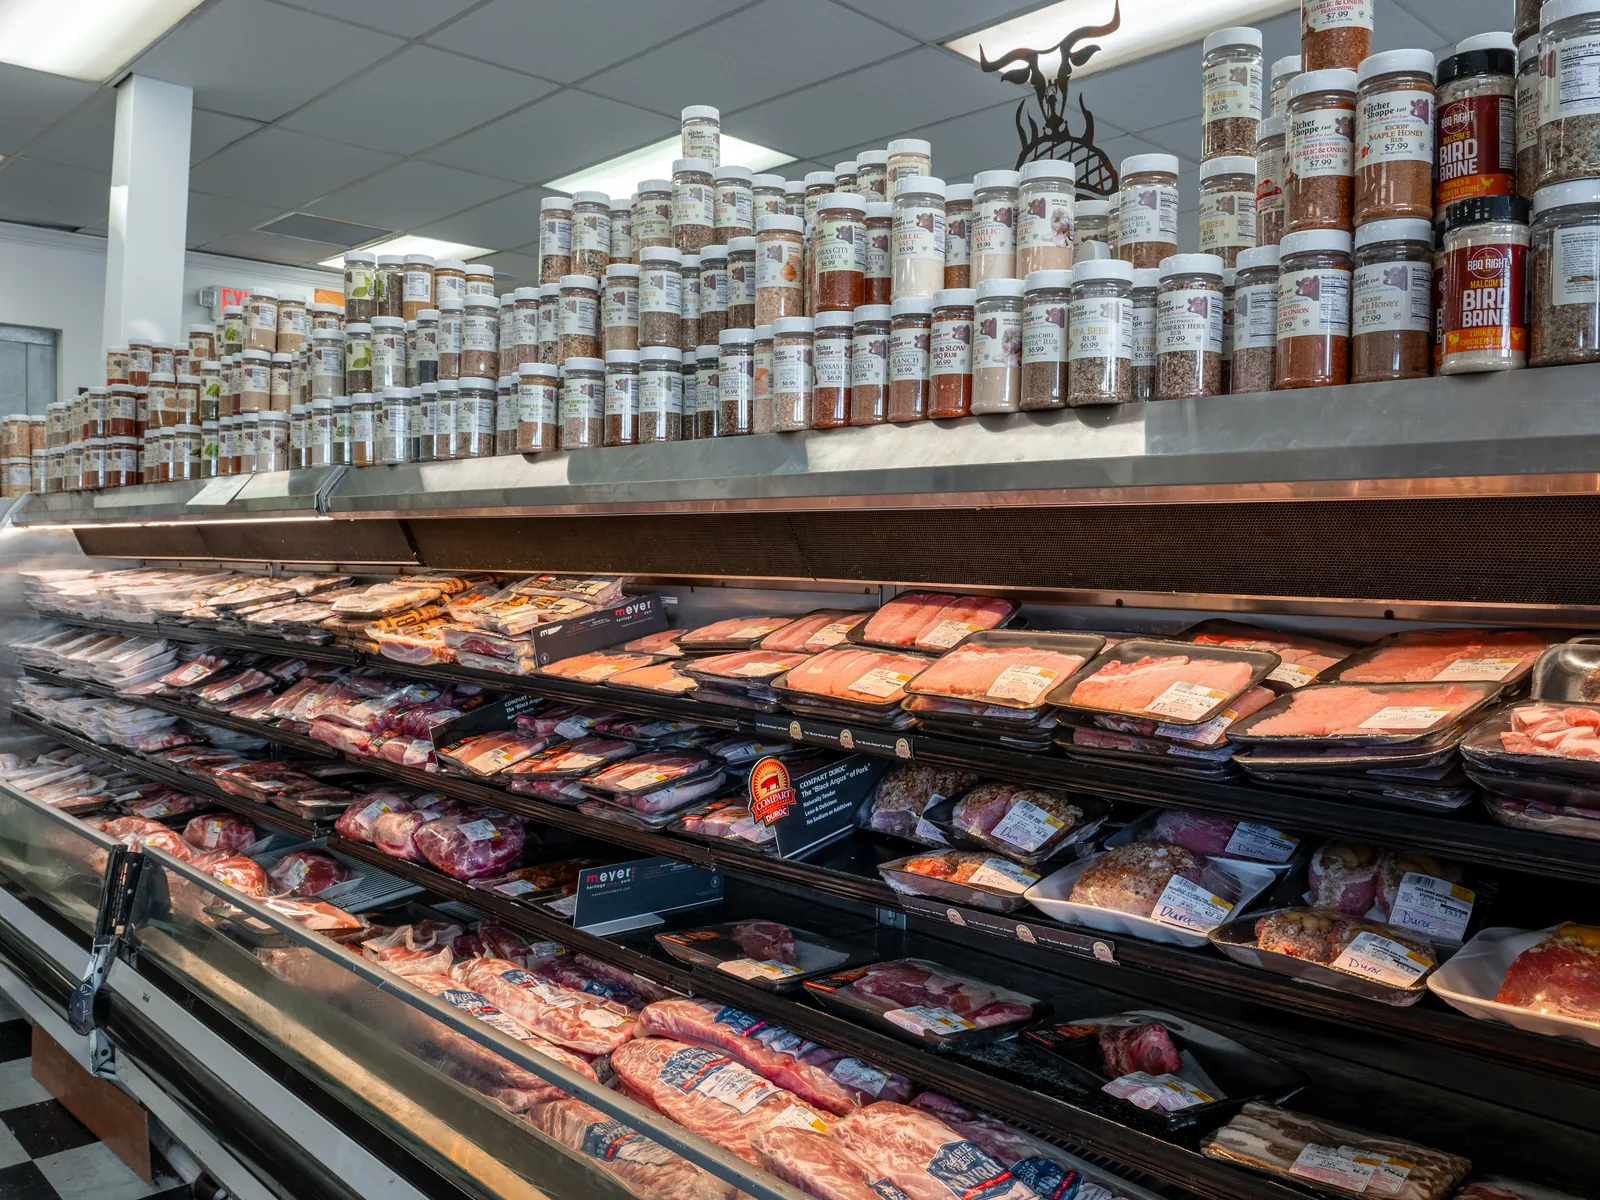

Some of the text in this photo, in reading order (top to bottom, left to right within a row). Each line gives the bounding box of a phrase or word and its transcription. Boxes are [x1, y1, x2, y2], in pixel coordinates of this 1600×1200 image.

[1311, 2, 1333, 12] GARLIC
[1320, 5, 1354, 14] SEASONING
[1326, 11, 1348, 20] $7.99
[1217, 90, 1239, 99] BEER
[1212, 98, 1227, 106] RUB
[1211, 104, 1228, 113] $6.99
[1363, 101, 1391, 115] Butcher
[1367, 108, 1394, 120] Shoppe
[1441, 110, 1474, 129] BBQ RIGHT
[1369, 131, 1396, 142] MAPLE
[1443, 131, 1471, 145] MALCOM'S
[1384, 142, 1408, 151] $7.99
[1294, 149, 1316, 158] GARLIC
[1303, 153, 1337, 162] SEASONING
[1440, 138, 1478, 167] BIRD
[1309, 159, 1332, 167] $7.99
[1440, 158, 1478, 183] BRINE
[1444, 180, 1465, 190] TURKEY
[1461, 184, 1480, 193] BRINE
[1206, 219, 1225, 228] BEER
[894, 233, 923, 241] GARLIC
[972, 228, 1000, 236] GARLIC
[1467, 257, 1510, 271] BBQ RIGHT
[1288, 307, 1310, 315] ONION
[1361, 314, 1381, 324] $7.99
[1463, 310, 1504, 327] BRIN
[1470, 329, 1495, 337] TURKEY
[946, 344, 966, 352] SLOW
[1028, 346, 1044, 354] $6.99
[1080, 341, 1099, 349] $6.99
[615, 600, 651, 616] meyer
[504, 695, 528, 707] COMPART
[799, 772, 828, 789] COMPART
[801, 790, 812, 798] The
[850, 770, 856, 778] of
[756, 790, 792, 811] COMPART
[803, 790, 836, 808] Naturally Tender
[804, 809, 816, 817] Lean
[819, 799, 838, 811] Delicious
[813, 812, 828, 822] Sodium
[833, 801, 853, 813] Additives
[766, 807, 787, 822] DUROC
[586, 867, 631, 883] meyer
[1160, 906, 1198, 926] Duroc
[1402, 911, 1437, 929] Duroc
[1349, 957, 1382, 975] Duroc
